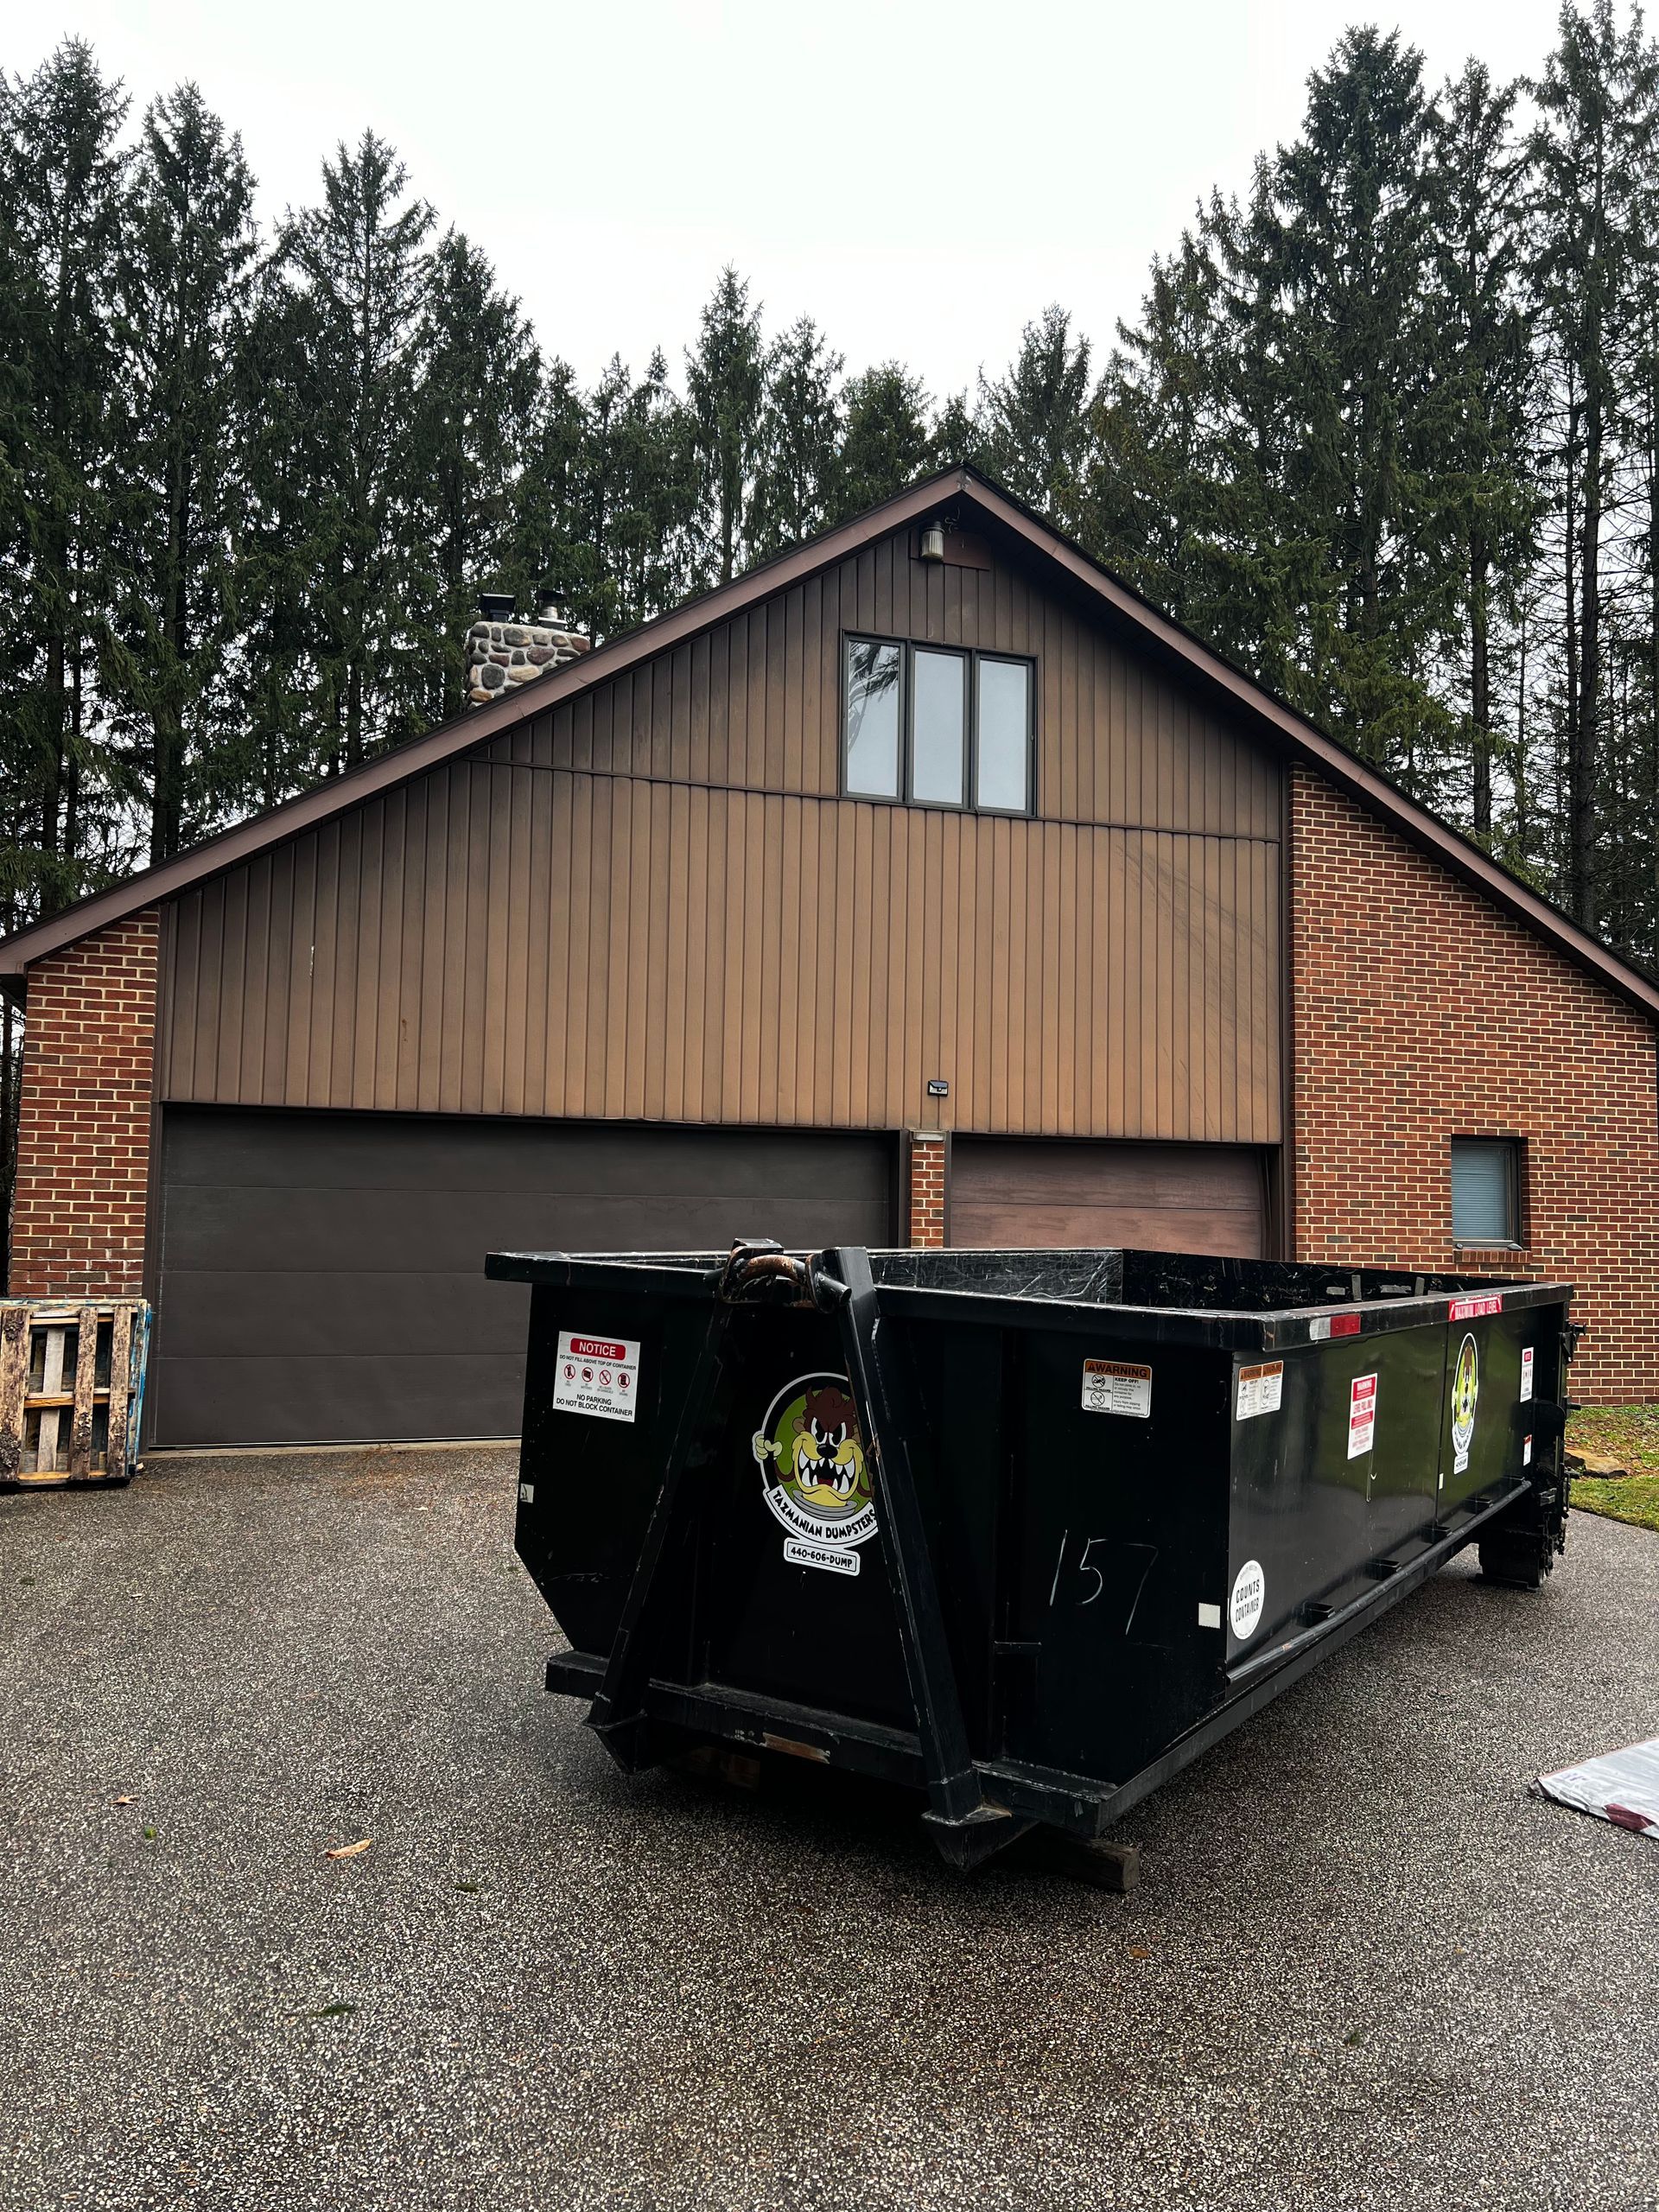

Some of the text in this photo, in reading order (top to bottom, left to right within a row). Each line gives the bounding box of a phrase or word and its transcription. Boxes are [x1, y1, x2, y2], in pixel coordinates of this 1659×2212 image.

[579, 1341, 616, 1357] NOTICE
[613, 1362, 637, 1370] CONTAINER
[1095, 1363, 1147, 1378] WARNING
[578, 1402, 598, 1411] BLOCK
[599, 1404, 632, 1416] CONTAINER
[586, 1395, 612, 1406] PARKING
[772, 1491, 877, 1539] TAZMANIAN DUMPSTERS
[791, 1547, 853, 1568] 440-606-DUMP
[1049, 1529, 1159, 1635] 157
[1236, 1579, 1260, 1604] COUNTS
[1235, 1598, 1260, 1623] CONTAINER
